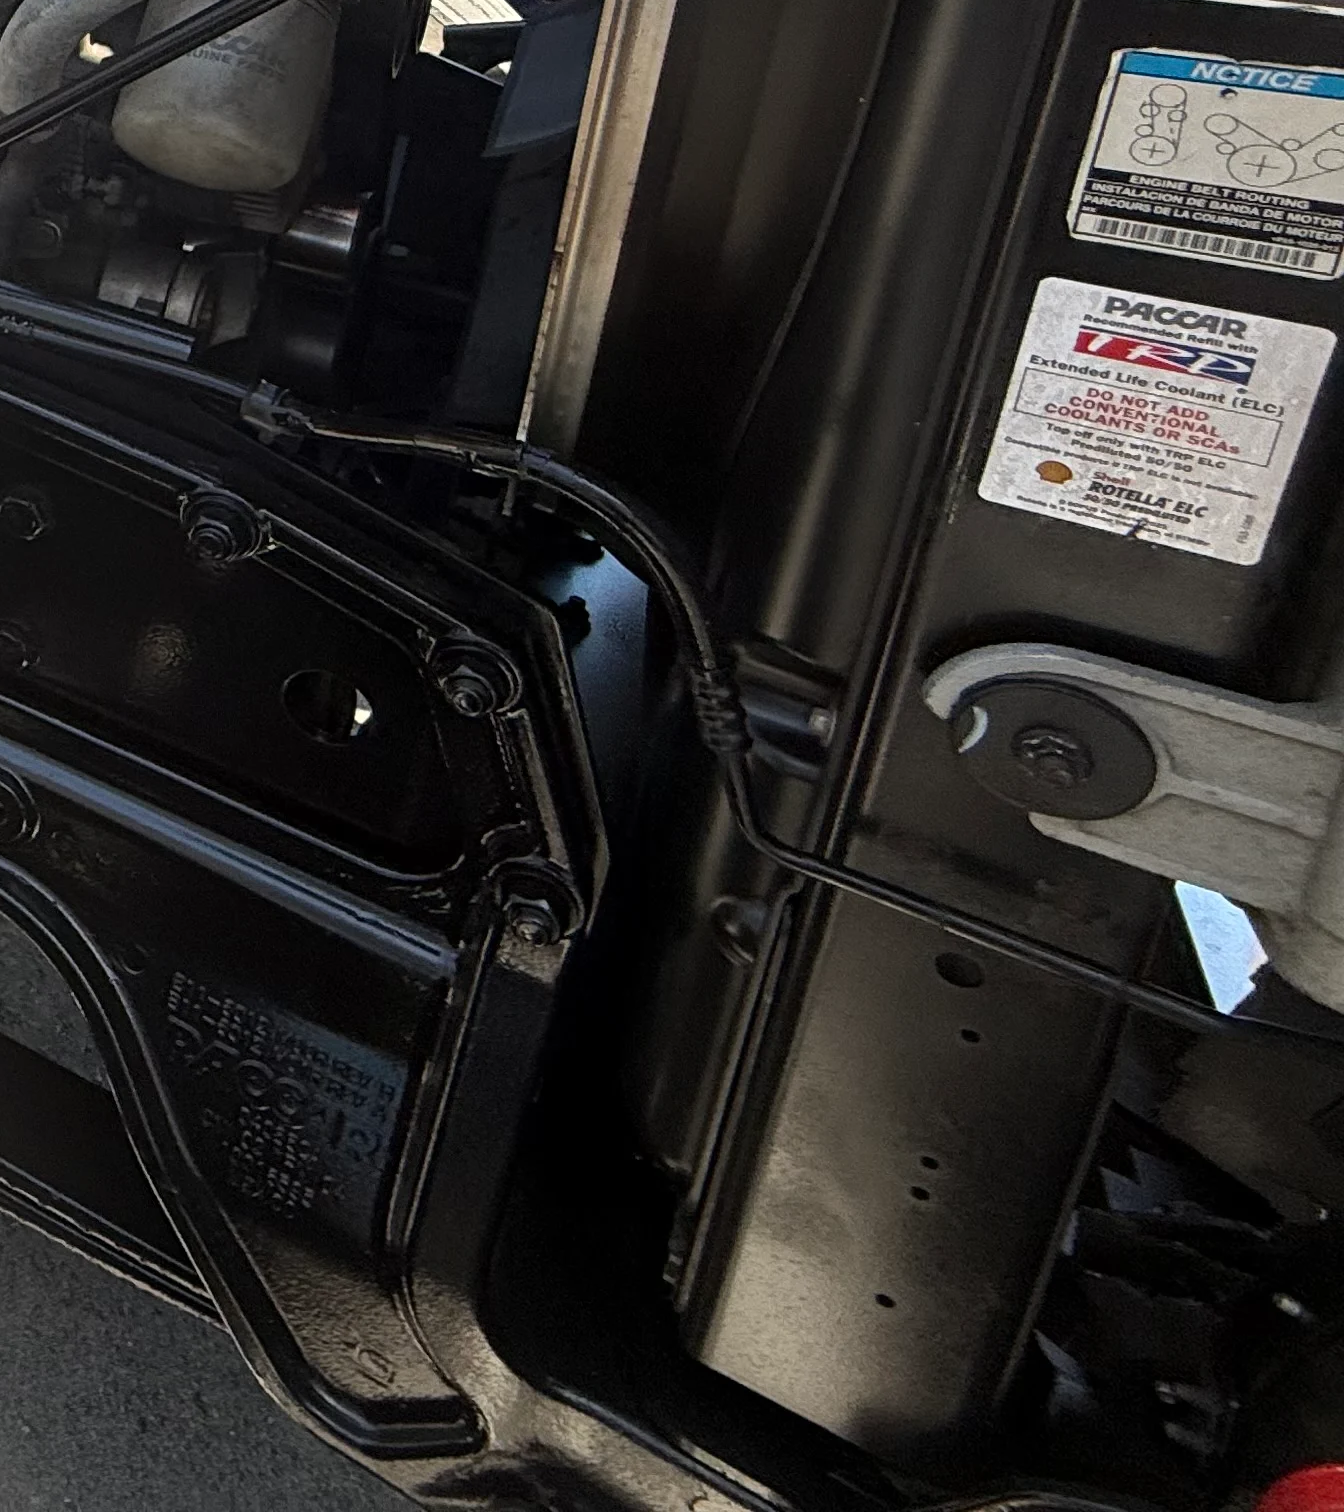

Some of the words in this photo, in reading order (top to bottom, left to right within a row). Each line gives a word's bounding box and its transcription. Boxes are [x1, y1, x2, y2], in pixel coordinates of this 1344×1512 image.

[1190, 62, 1320, 92] NOTICE
[1091, 183, 1184, 204] INSTALACION
[1187, 197, 1206, 208] DE
[1209, 200, 1259, 216] BANDA
[1263, 209, 1284, 220] DE
[1286, 212, 1343, 229] MOTOR
[1128, 175, 1188, 192] ENGINE
[1192, 183, 1231, 199] BELT
[1235, 190, 1311, 210] ROUTING
[1083, 194, 1151, 214] PARCOURS
[1153, 205, 1172, 217] DE
[1174, 208, 1190, 220] LA
[1192, 211, 1261, 230] COURROIE
[1263, 221, 1283, 233] DU
[1285, 226, 1343, 243] MOTEUR
[1083, 313, 1183, 340] Recommended
[1187, 334, 1224, 348] Refill
[1227, 341, 1259, 354] with
[1103, 295, 1247, 339] PACCAR
[1084, 331, 1252, 375] TRP
[1029, 354, 1110, 380] Extended
[1116, 371, 1148, 388] Life
[1155, 380, 1226, 405] Coolant
[1231, 396, 1285, 417] (ELC)
[1087, 387, 1113, 402] DO
[1122, 393, 1162, 413] NOT
[1167, 404, 1211, 422] ADD
[1044, 403, 1145, 434] COOLANTS
[1152, 425, 1182, 441] OR
[1188, 433, 1241, 455] SCAs
[1069, 396, 1221, 438] CONVENTIONAL
[1046, 422, 1071, 439] Top
[1074, 429, 1093, 440] off
[1096, 434, 1124, 448] only
[1129, 442, 1160, 456] with
[1165, 448, 1194, 462] TRP
[1197, 456, 1227, 470] ELC
[1146, 454, 1193, 473] 50/50
[1088, 480, 1167, 509] ROTELLA
[1172, 500, 1209, 518] ELC
[1093, 471, 1132, 486] Shell
